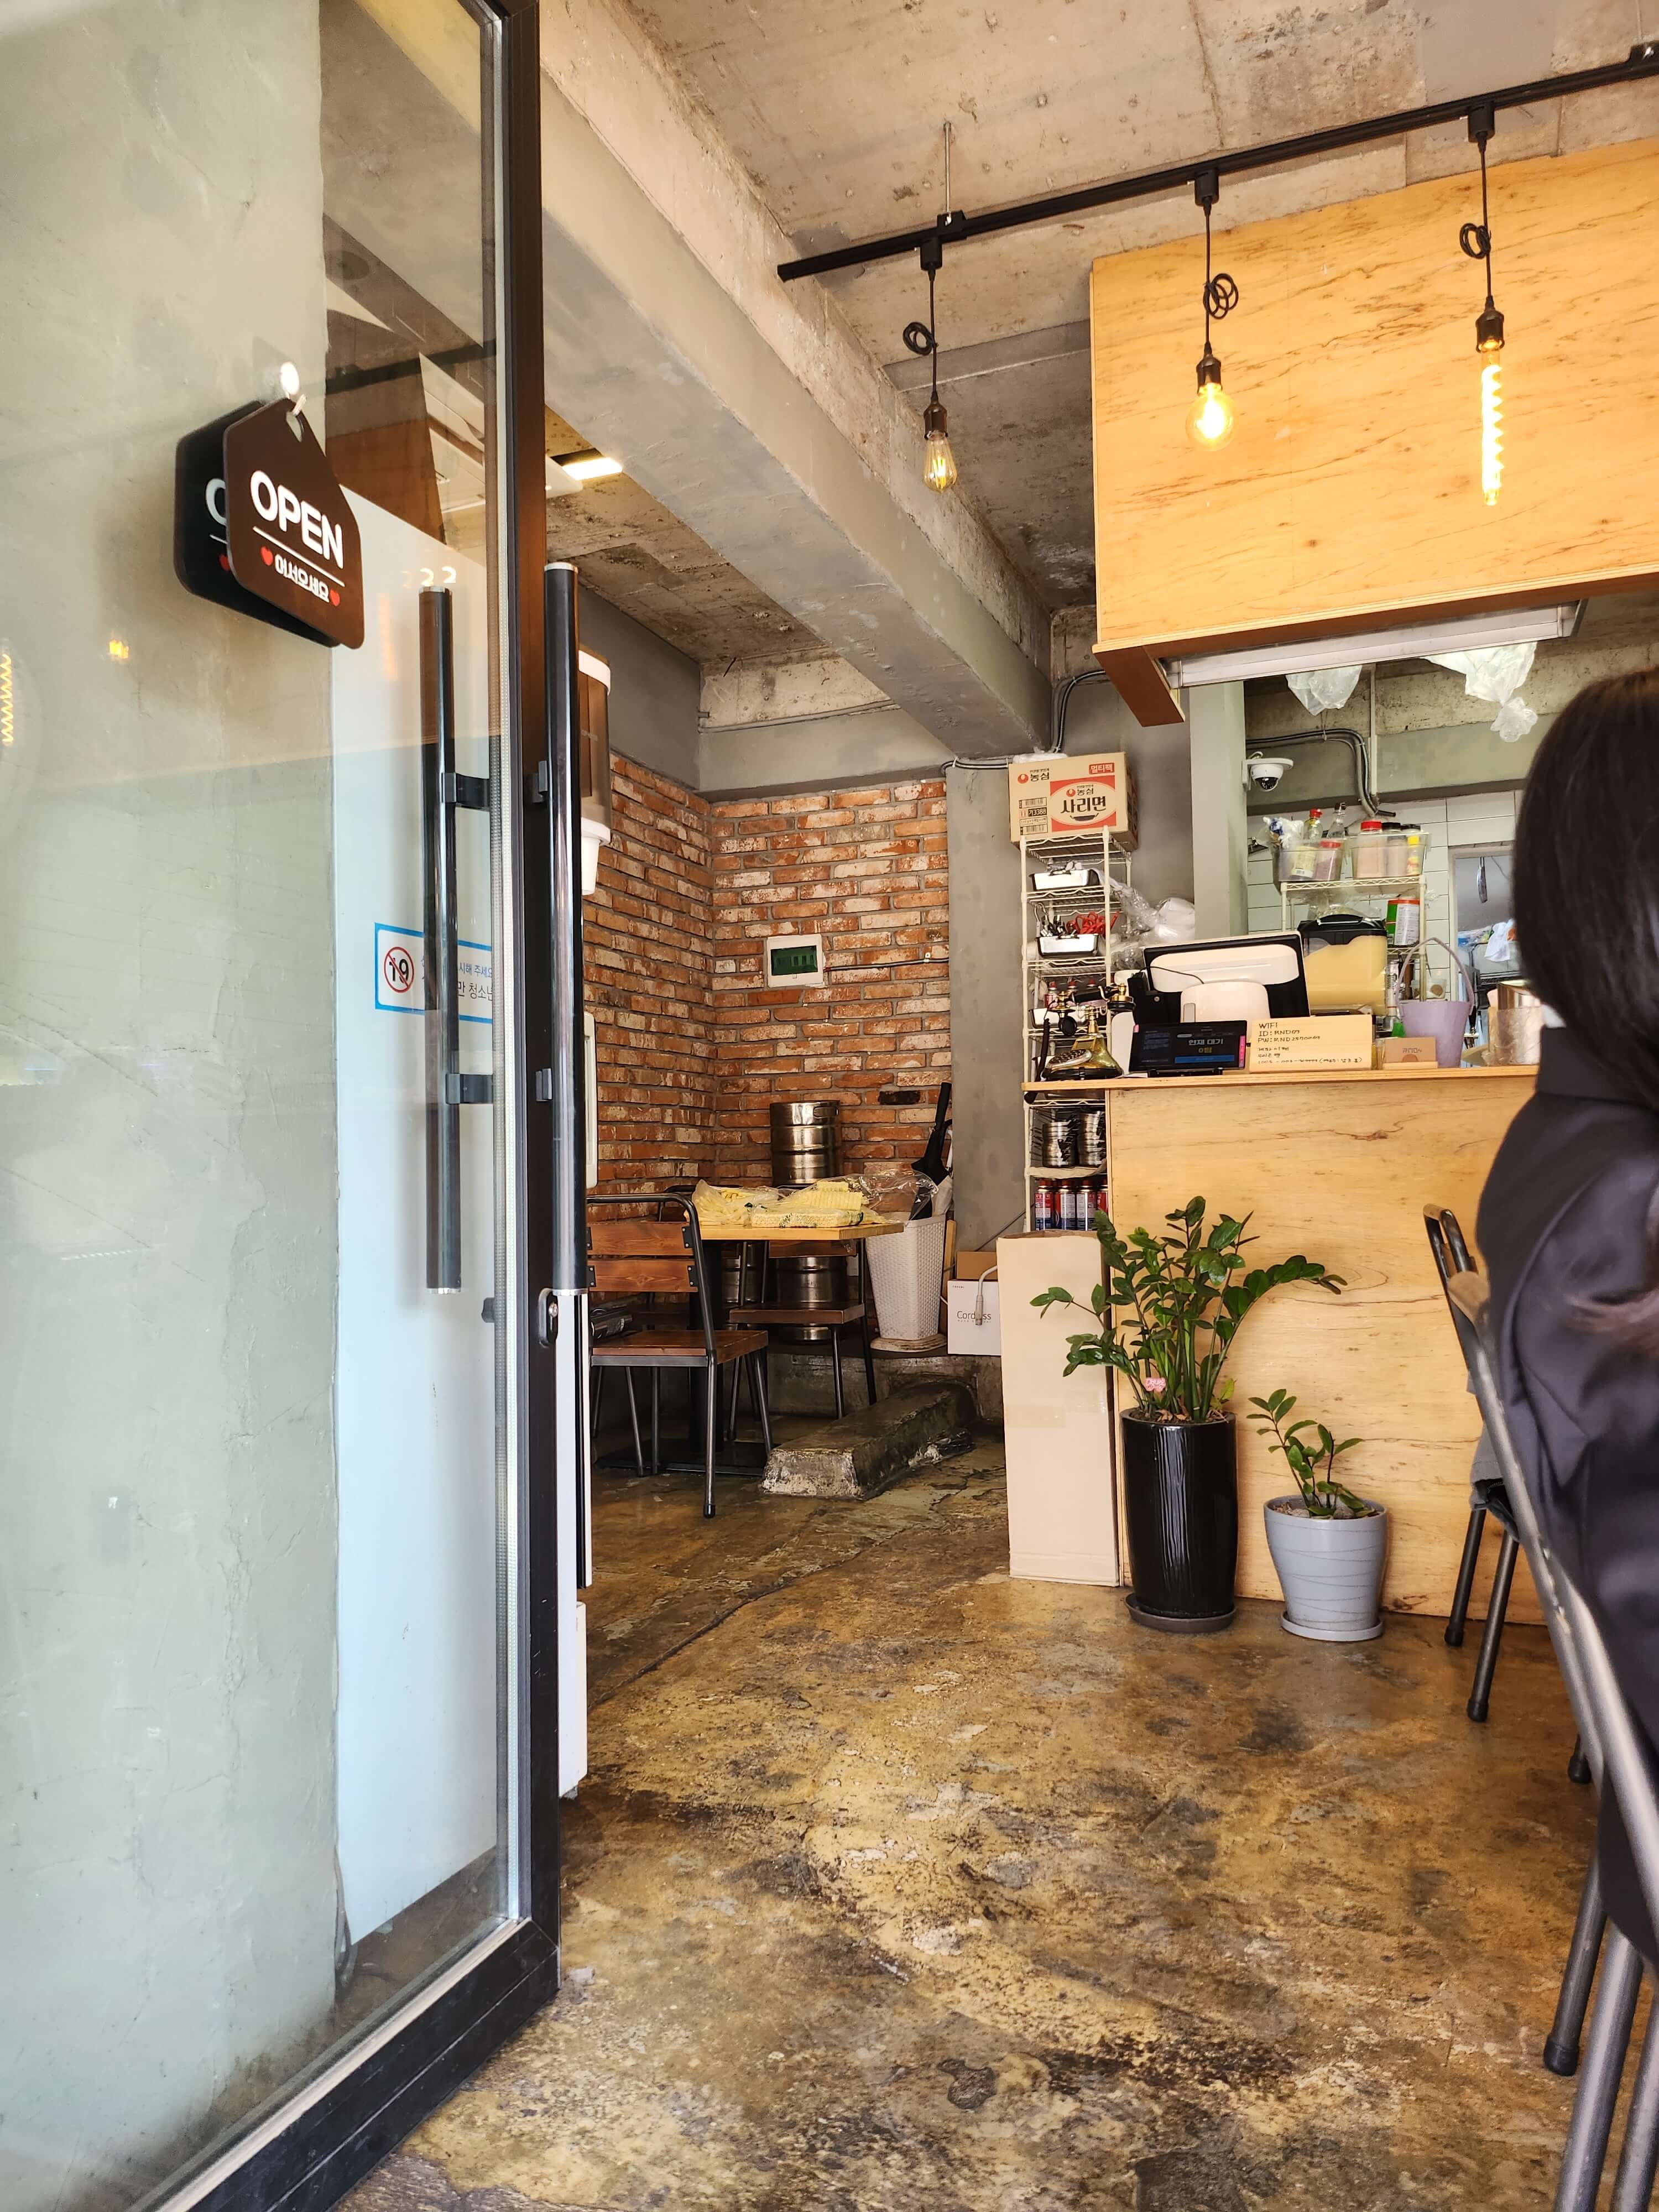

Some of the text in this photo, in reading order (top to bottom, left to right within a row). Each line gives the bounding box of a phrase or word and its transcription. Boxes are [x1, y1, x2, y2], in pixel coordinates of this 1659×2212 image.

[250, 470, 343, 569] OPEN
[275, 554, 330, 602] 어서오세요
[1030, 772, 1049, 782] 농심
[1077, 787, 1094, 796] 농심
[1060, 796, 1107, 814] 사리면
[957, 1311, 992, 1320] Cordss
